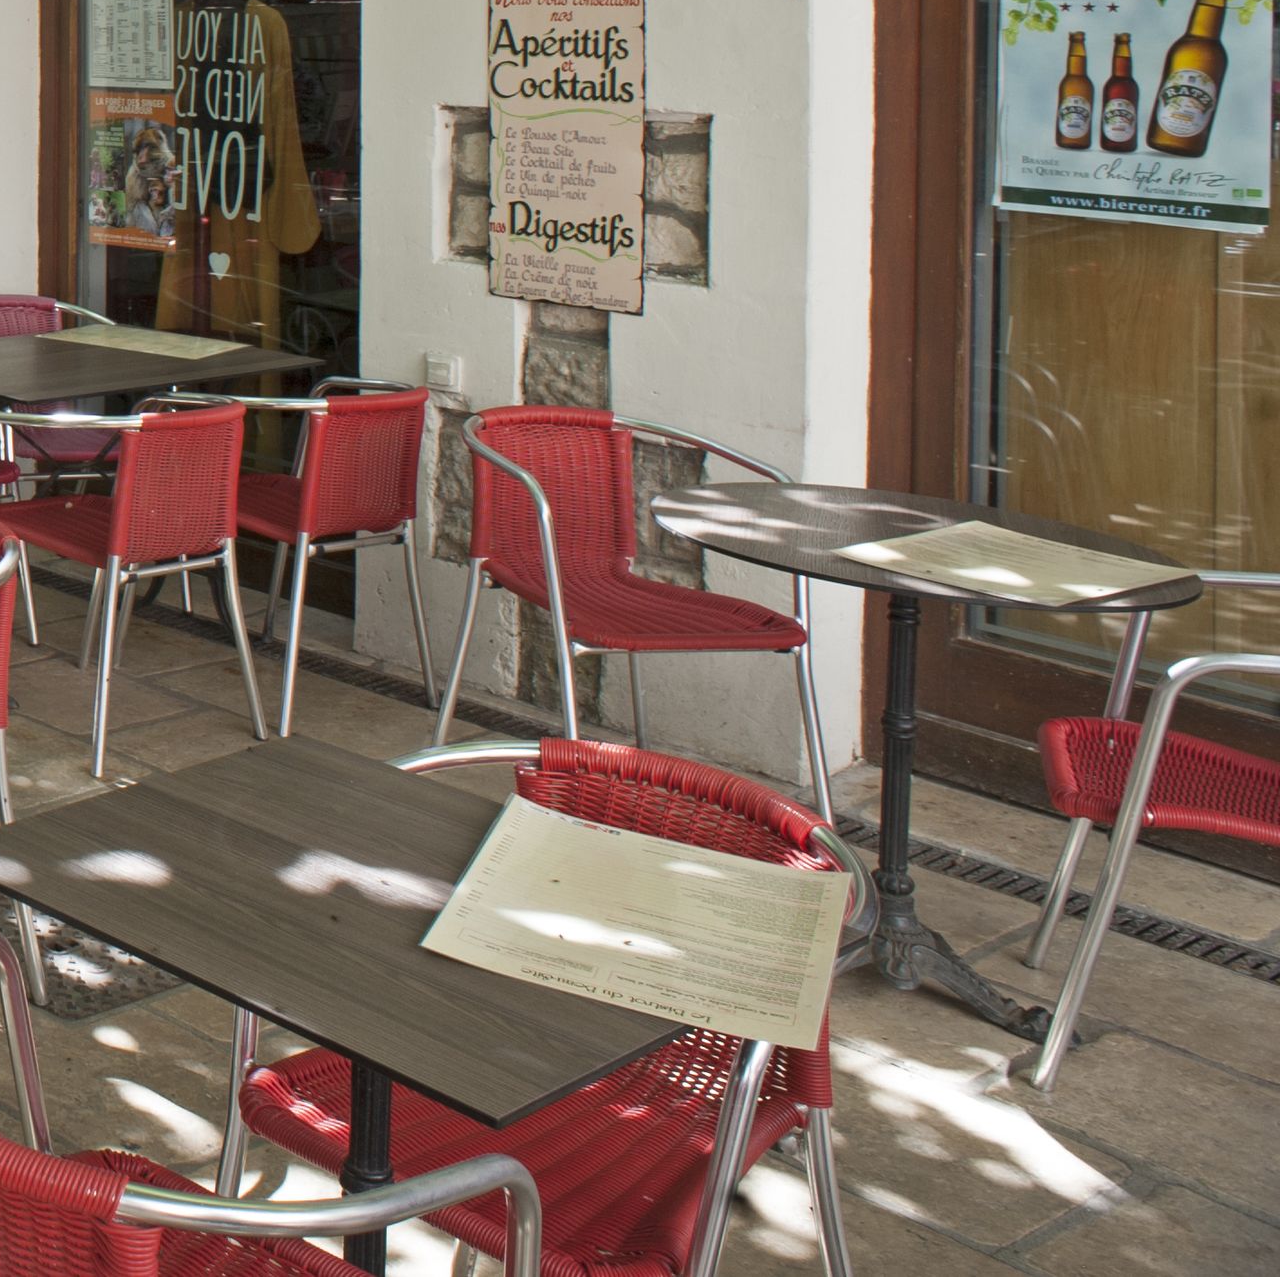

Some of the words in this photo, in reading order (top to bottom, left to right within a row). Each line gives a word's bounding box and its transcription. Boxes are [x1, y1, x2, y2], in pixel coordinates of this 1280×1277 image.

[550, 9, 574, 23] nos
[492, 18, 629, 69] Apéritifs
[561, 60, 575, 73] et
[491, 61, 634, 103] Cocktails
[1165, 86, 1213, 104] RATZ
[505, 127, 517, 139] Le
[521, 127, 557, 141] Pousse
[505, 142, 516, 153] Le
[521, 141, 550, 155] Beau
[553, 145, 575, 157] Site
[505, 156, 516, 167] Le
[520, 155, 564, 170] Cocktail
[569, 159, 582, 172] de
[505, 169, 516, 180] Le
[542, 171, 555, 184] de
[1169, 168, 1238, 188] RATZ
[505, 182, 516, 194] Le
[1050, 195, 1212, 218] www.biereratz.fr
[508, 200, 634, 257] Digestifs
[505, 253, 519, 266] La
[523, 253, 559, 271] Vieille
[564, 263, 597, 275] prune
[504, 268, 519, 280] La
[558, 274, 571, 287] de
[576, 278, 599, 291] noix
[550, 286, 561, 299] de
